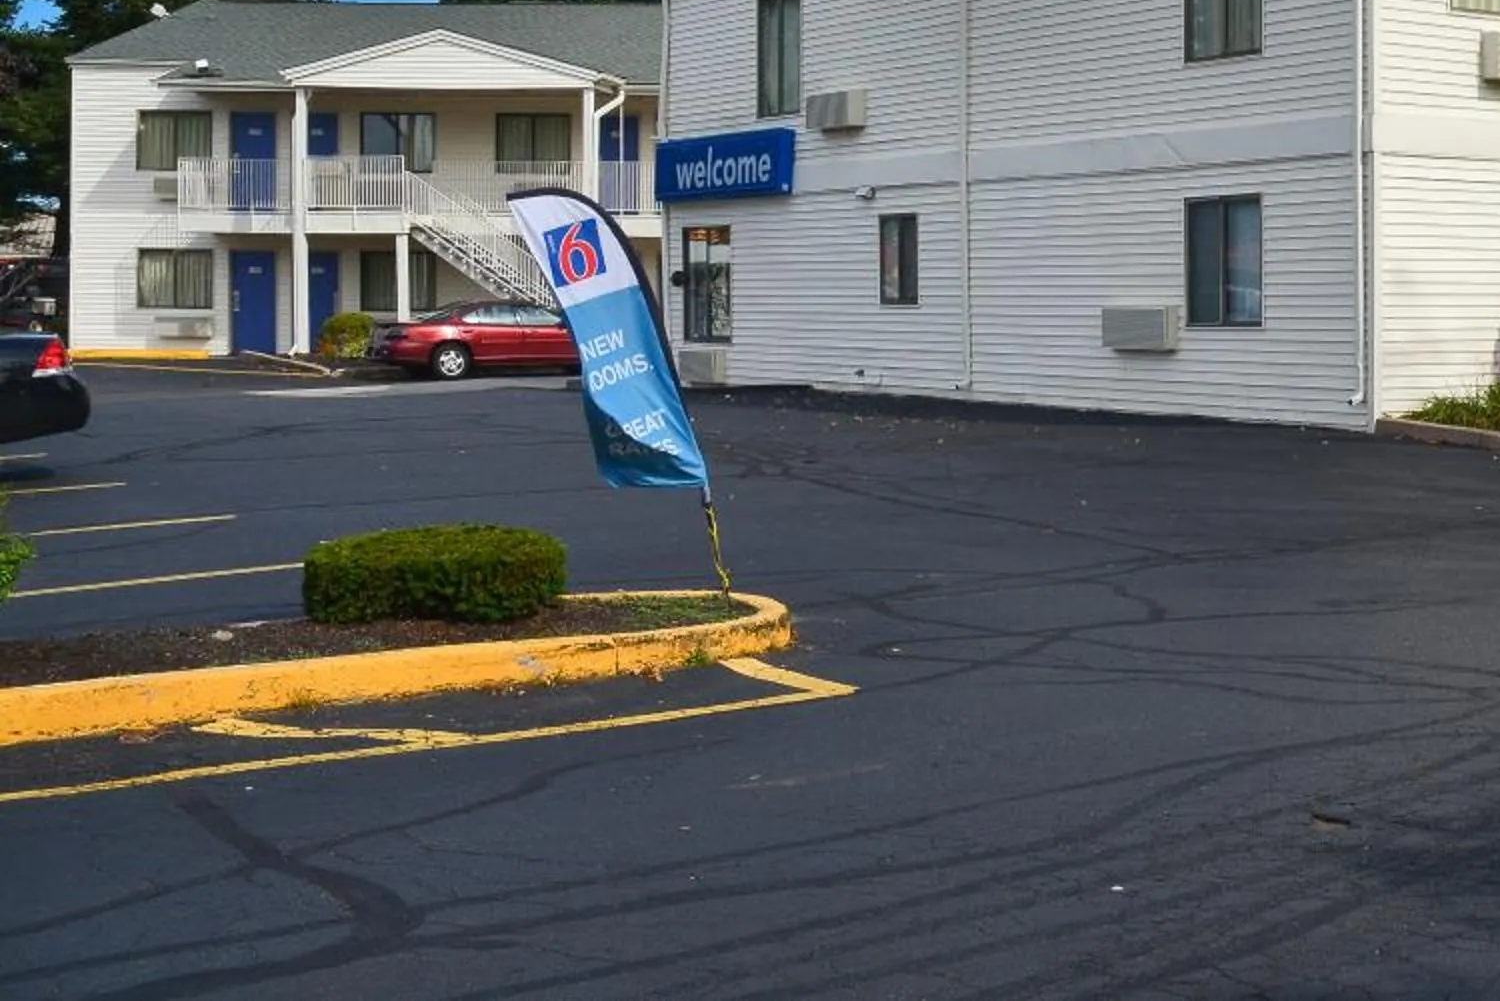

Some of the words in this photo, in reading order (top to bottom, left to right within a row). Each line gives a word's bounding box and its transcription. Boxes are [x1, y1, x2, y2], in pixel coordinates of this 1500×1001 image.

[676, 146, 771, 190] welcome
[558, 221, 599, 285] 6
[579, 328, 625, 362] NEW
[588, 353, 654, 392] OOMS.
